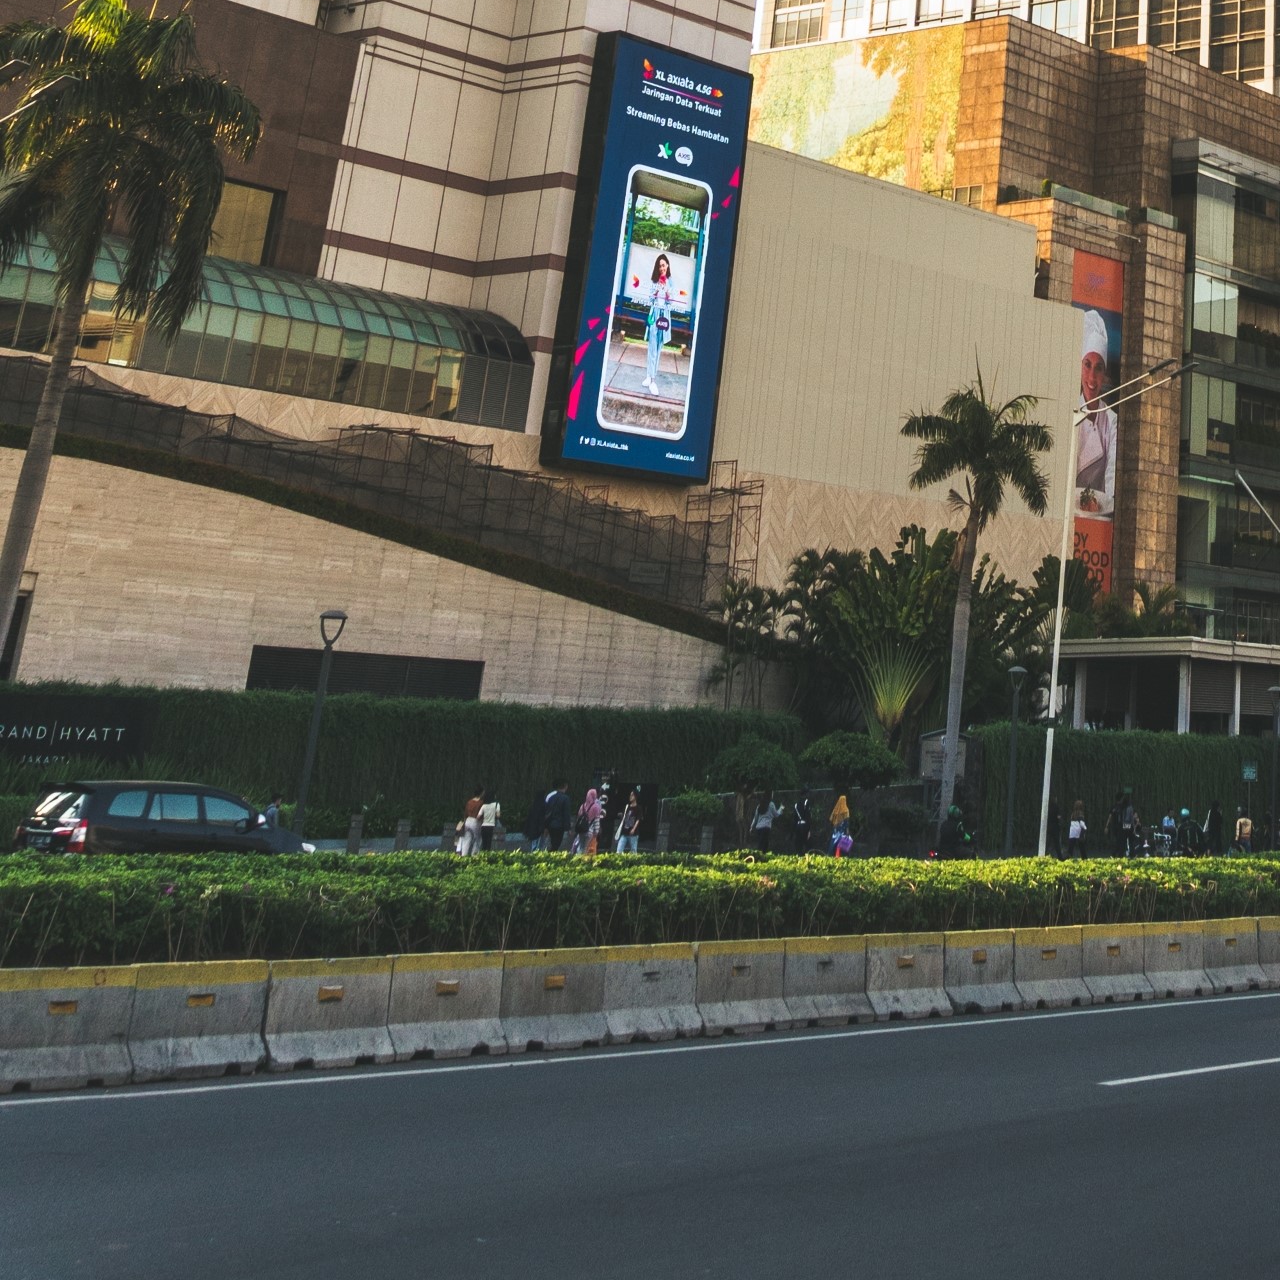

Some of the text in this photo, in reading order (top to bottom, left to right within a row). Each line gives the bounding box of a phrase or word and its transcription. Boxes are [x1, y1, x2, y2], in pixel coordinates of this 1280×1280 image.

[655, 70, 666, 81] XL
[641, 85, 722, 117] Jaringan Data Terkuat
[626, 105, 730, 144] Streaming Bebas Hambatan
[60, 727, 125, 742] HYATT
